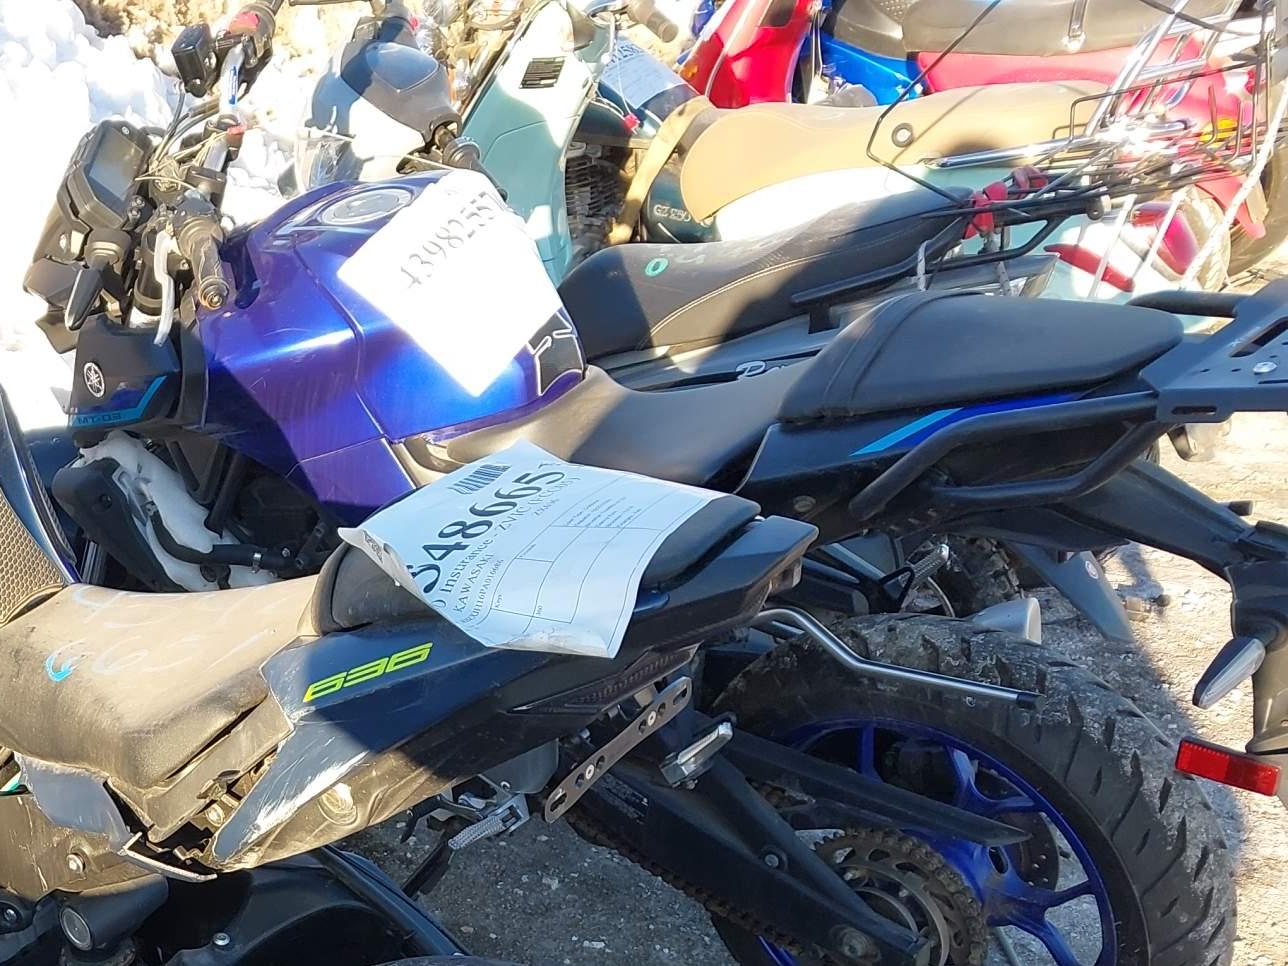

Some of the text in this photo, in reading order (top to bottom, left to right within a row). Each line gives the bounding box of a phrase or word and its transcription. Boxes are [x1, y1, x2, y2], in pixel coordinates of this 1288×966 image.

[440, 538, 494, 594] Insurance
[453, 553, 496, 614] KAWASAKI
[303, 642, 433, 703] 636
